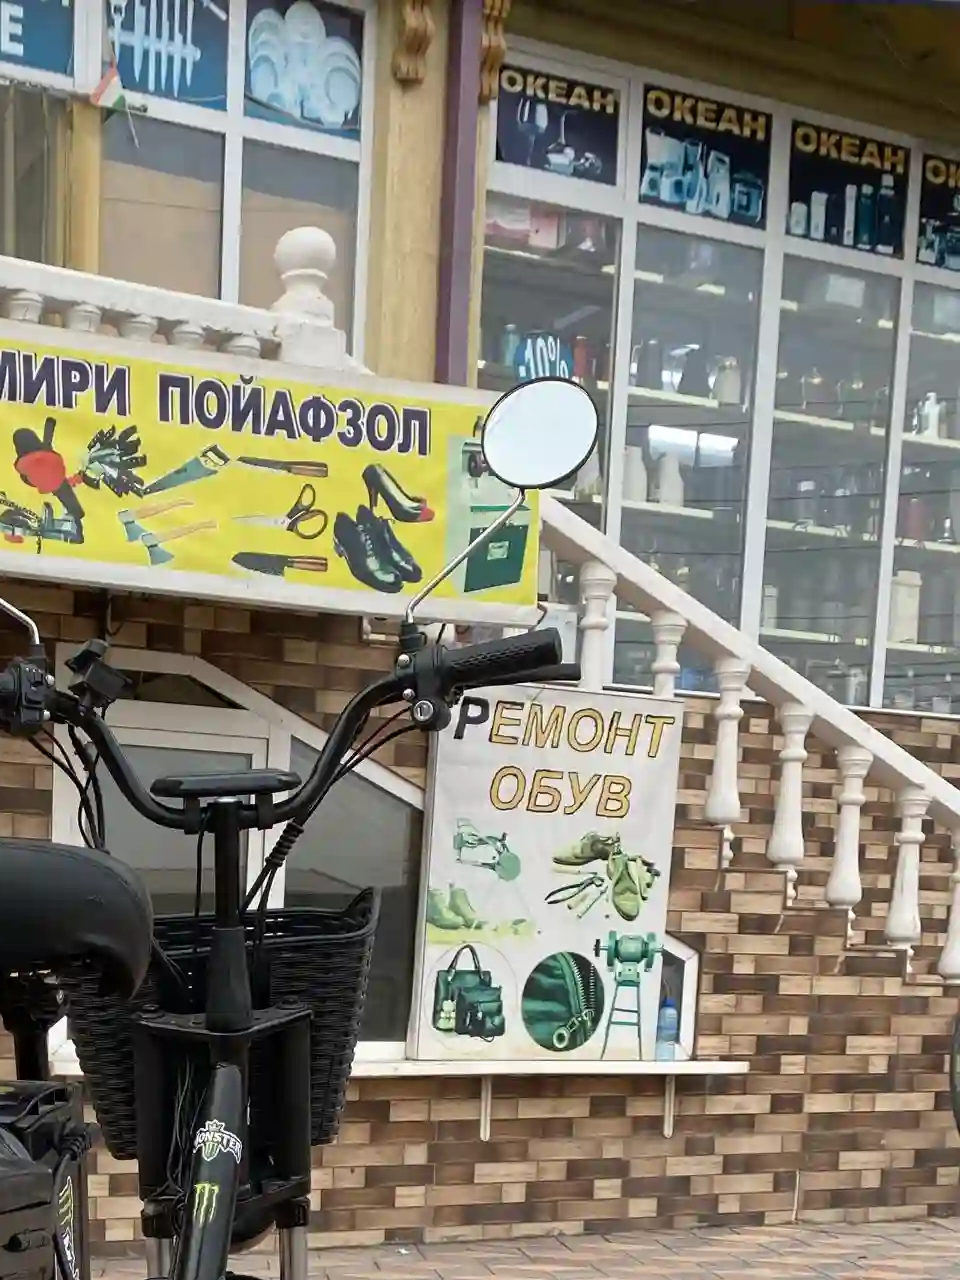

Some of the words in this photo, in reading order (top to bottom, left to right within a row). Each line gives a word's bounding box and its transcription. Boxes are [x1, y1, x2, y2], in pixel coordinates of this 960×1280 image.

[500, 69, 615, 114] ОКЕАН
[646, 89, 767, 141] ОКЕАН
[795, 125, 906, 176] ОКЕАН
[157, 373, 432, 456] ПОЙАФЗОЛ
[453, 695, 676, 758] РЕМОНТ
[489, 765, 633, 818] ОБУВ
